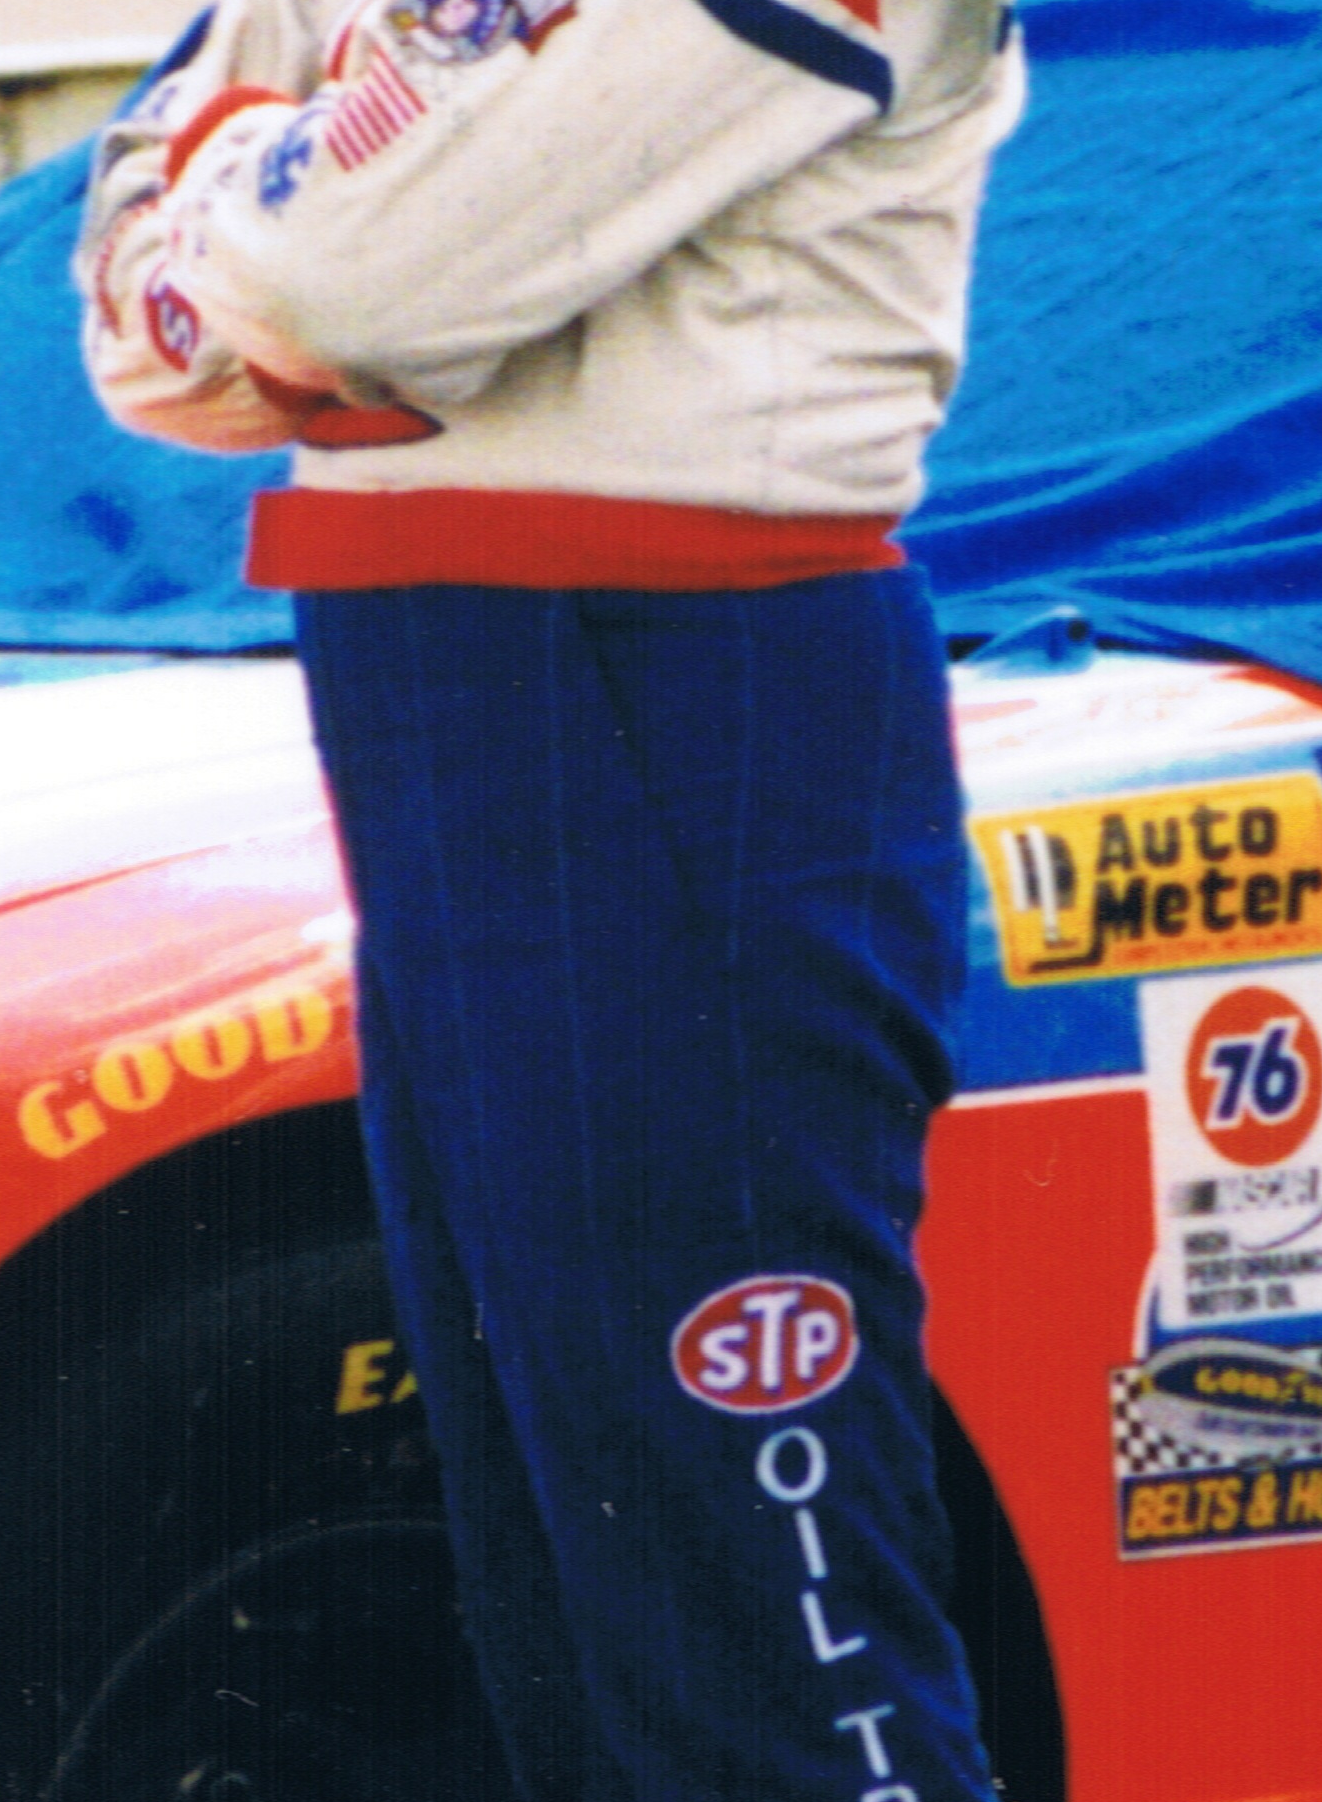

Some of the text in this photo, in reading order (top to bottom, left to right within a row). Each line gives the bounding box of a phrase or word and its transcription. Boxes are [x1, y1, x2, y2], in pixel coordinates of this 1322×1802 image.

[1097, 802, 1280, 874] Auto
[1202, 1019, 1306, 1127] 76
[698, 1289, 840, 1392] STP
[755, 1425, 868, 1664] OIL
[1127, 1476, 1243, 1540] BELTS
[1245, 1472, 1276, 1529] &
